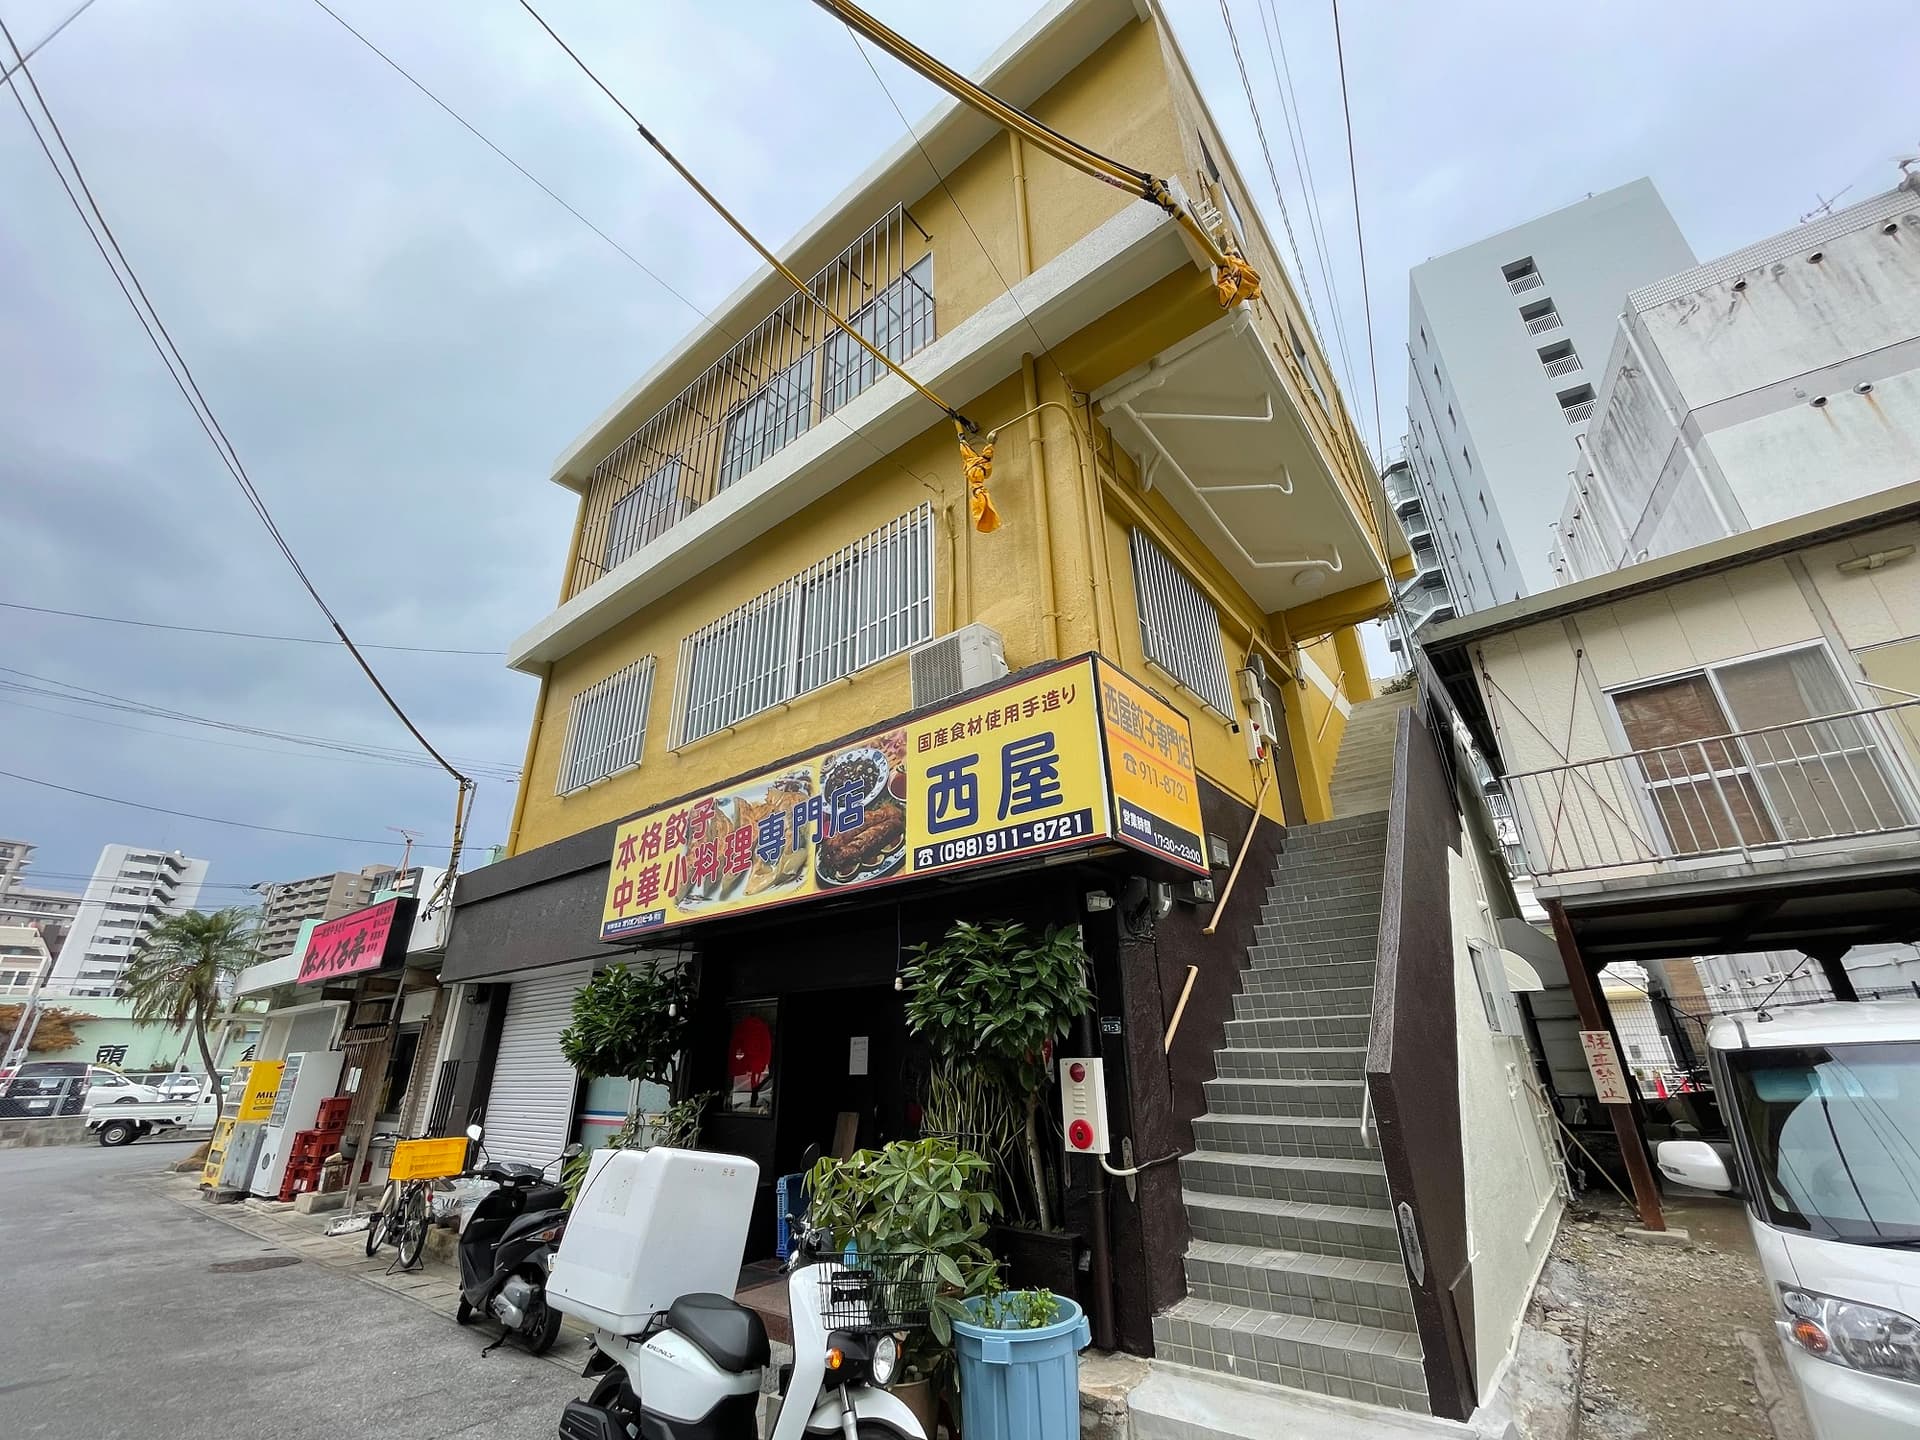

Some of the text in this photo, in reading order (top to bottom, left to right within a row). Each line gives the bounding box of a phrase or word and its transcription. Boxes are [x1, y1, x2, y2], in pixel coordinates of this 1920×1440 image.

[917, 683, 1076, 753] 国産食材使用手造り
[1102, 680, 1192, 771] 西屋餃子専門店
[926, 730, 1064, 835] 西屋
[1138, 759, 1189, 806] 911-8721
[616, 797, 715, 872] 本格餃子
[757, 778, 865, 863] 専門店
[938, 812, 1083, 864] (098)911-8721
[1122, 807, 1152, 837] 営業時間
[612, 824, 753, 917] 中華小料理
[1103, 1023, 1119, 1032] 21-3
